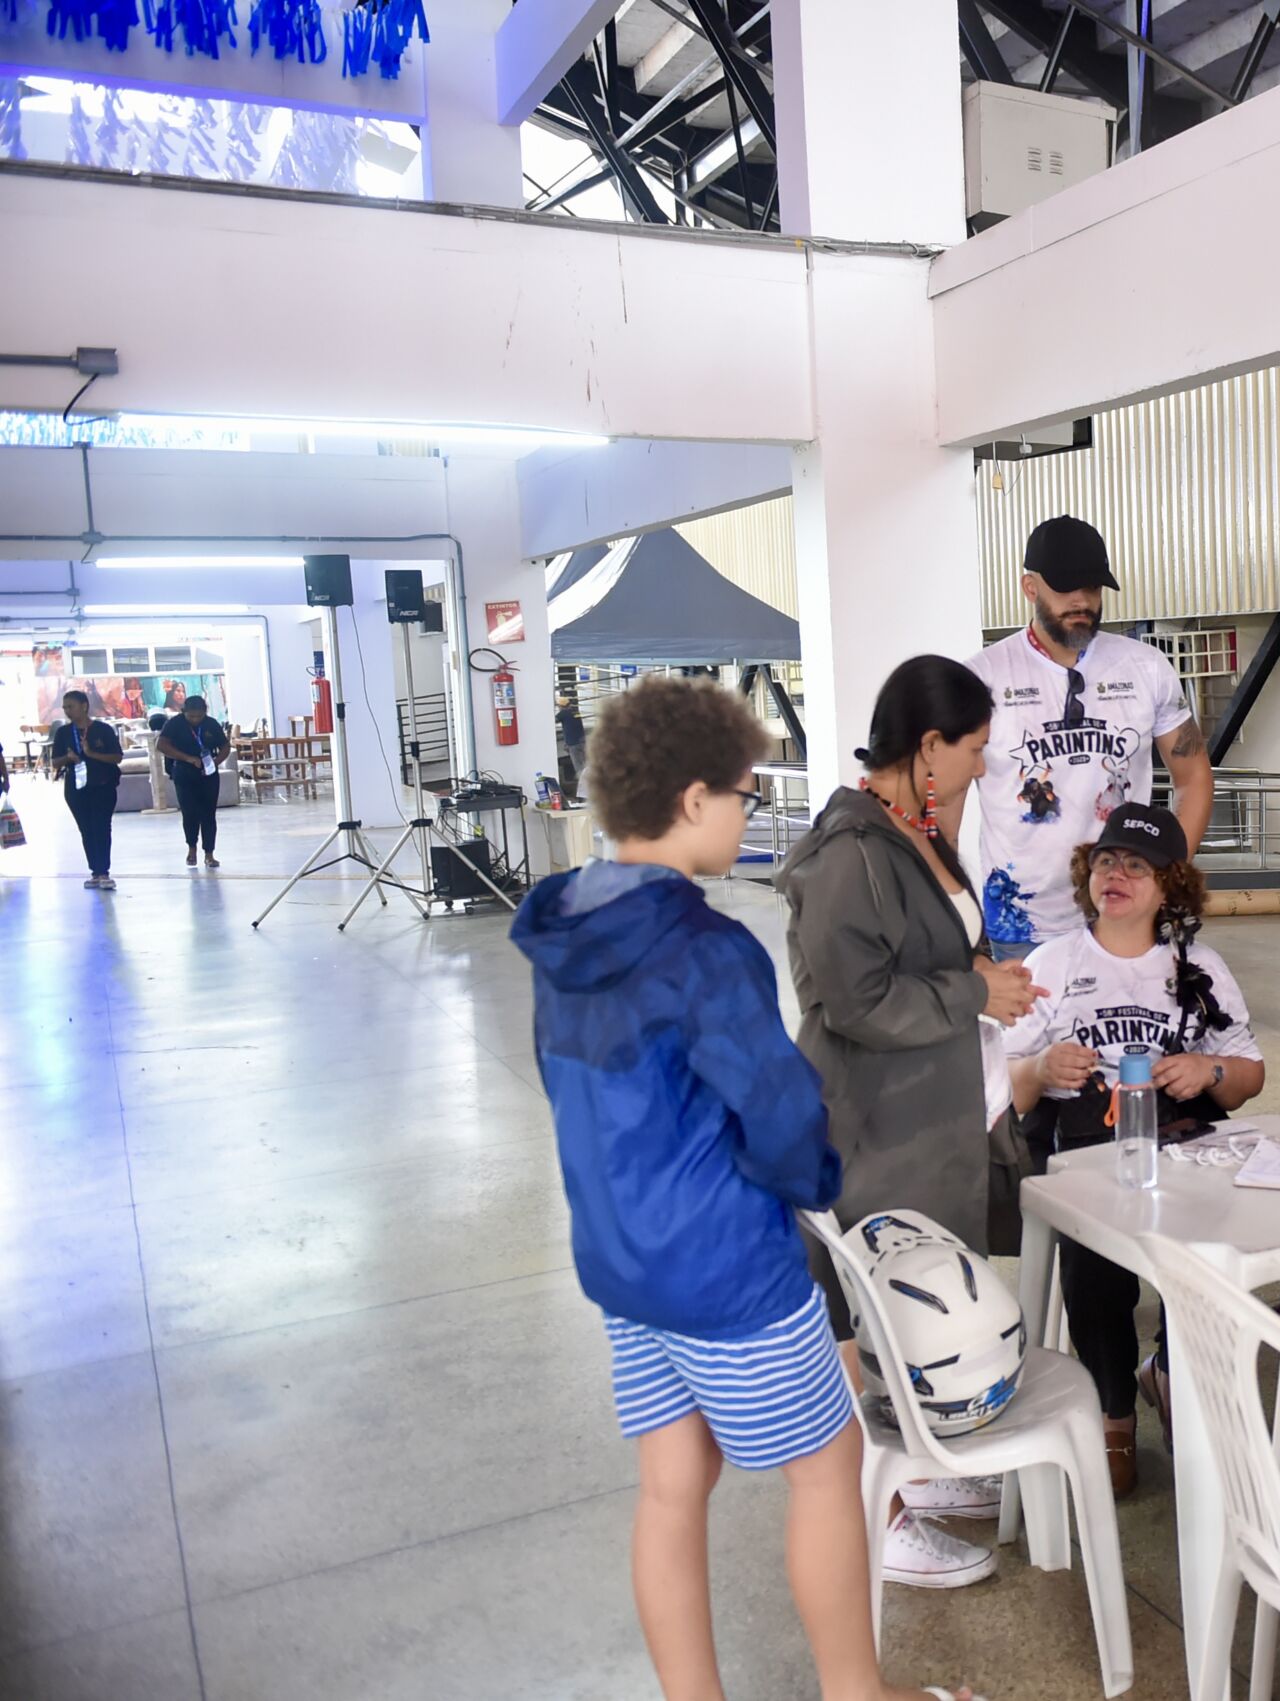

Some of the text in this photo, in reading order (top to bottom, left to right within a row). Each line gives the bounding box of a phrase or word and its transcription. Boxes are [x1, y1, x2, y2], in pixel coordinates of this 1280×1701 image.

[1026, 731, 1127, 764] PARINTINS
[1123, 818, 1160, 837] SEPCD
[1076, 1020, 1180, 1049] PARINTIN
